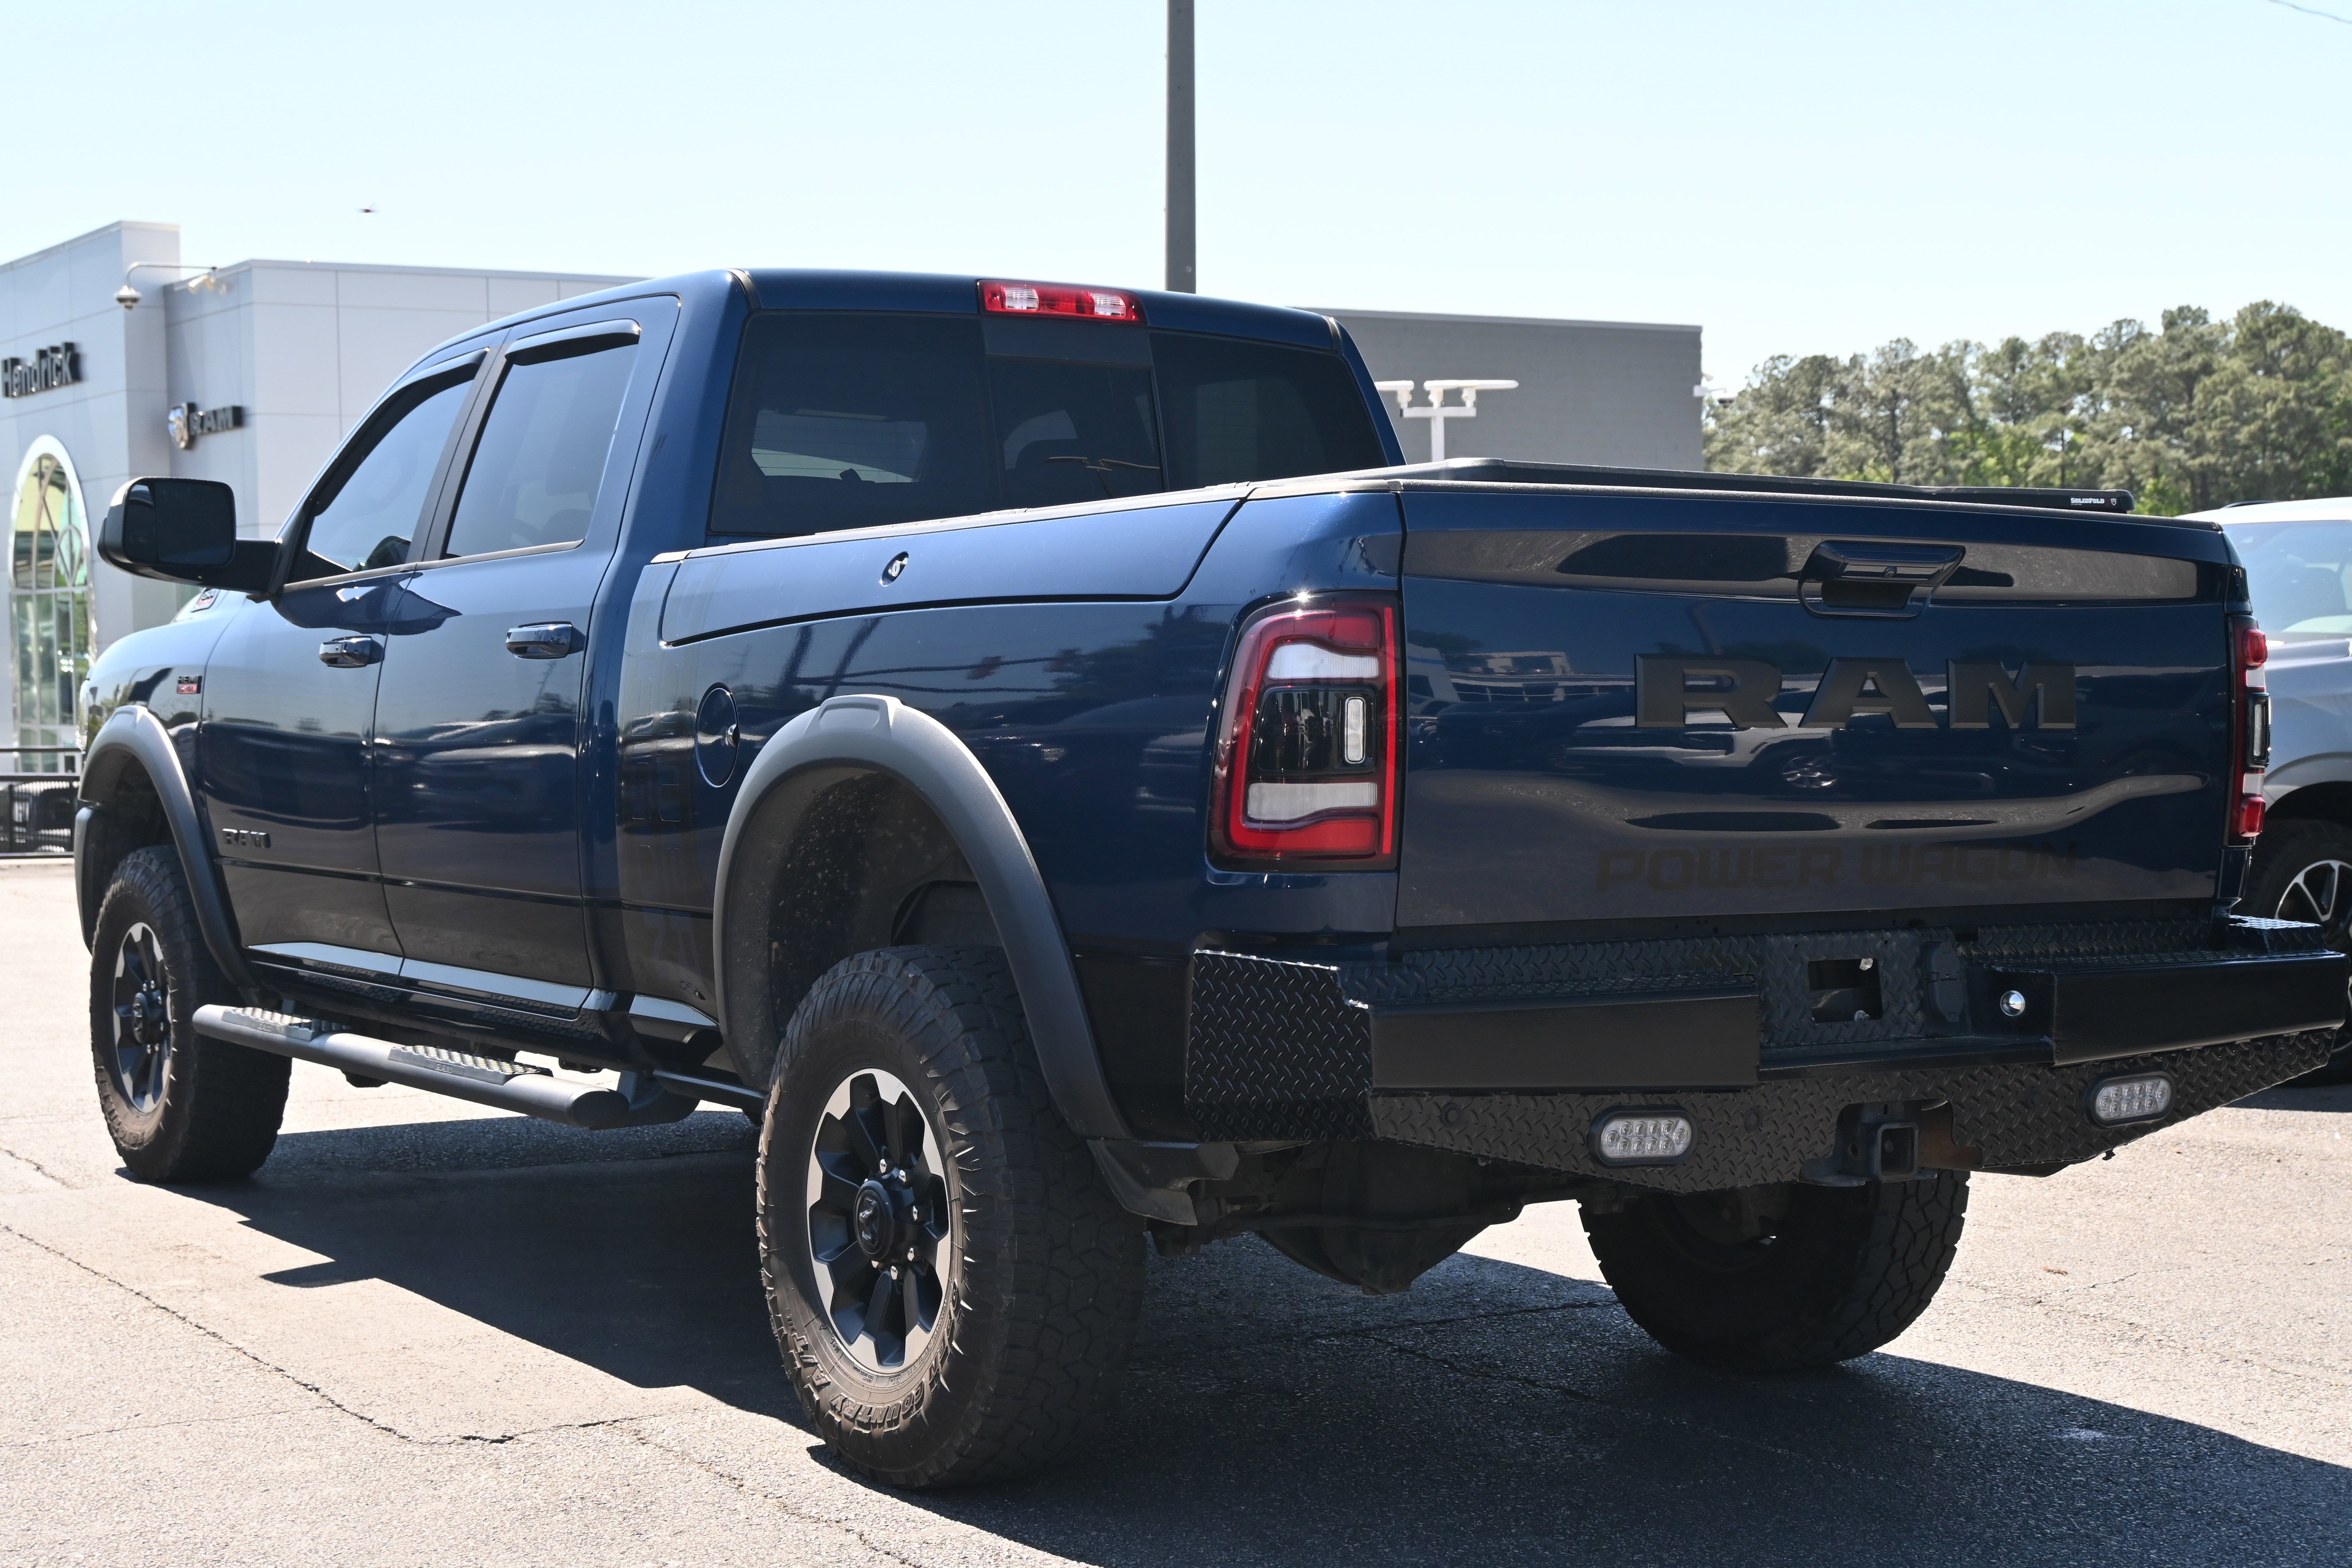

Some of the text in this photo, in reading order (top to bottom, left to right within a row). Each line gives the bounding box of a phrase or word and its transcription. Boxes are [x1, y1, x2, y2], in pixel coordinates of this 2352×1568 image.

[1, 342, 82, 397] Hendrick
[190, 406, 244, 436] RAM
[1633, 653, 2077, 729] RAM
[222, 828, 270, 848] RAM
[1596, 841, 2077, 892] POWER WAGON
[435, 1062, 453, 1074] RAM
[829, 1379, 925, 1424] COUNTRY
